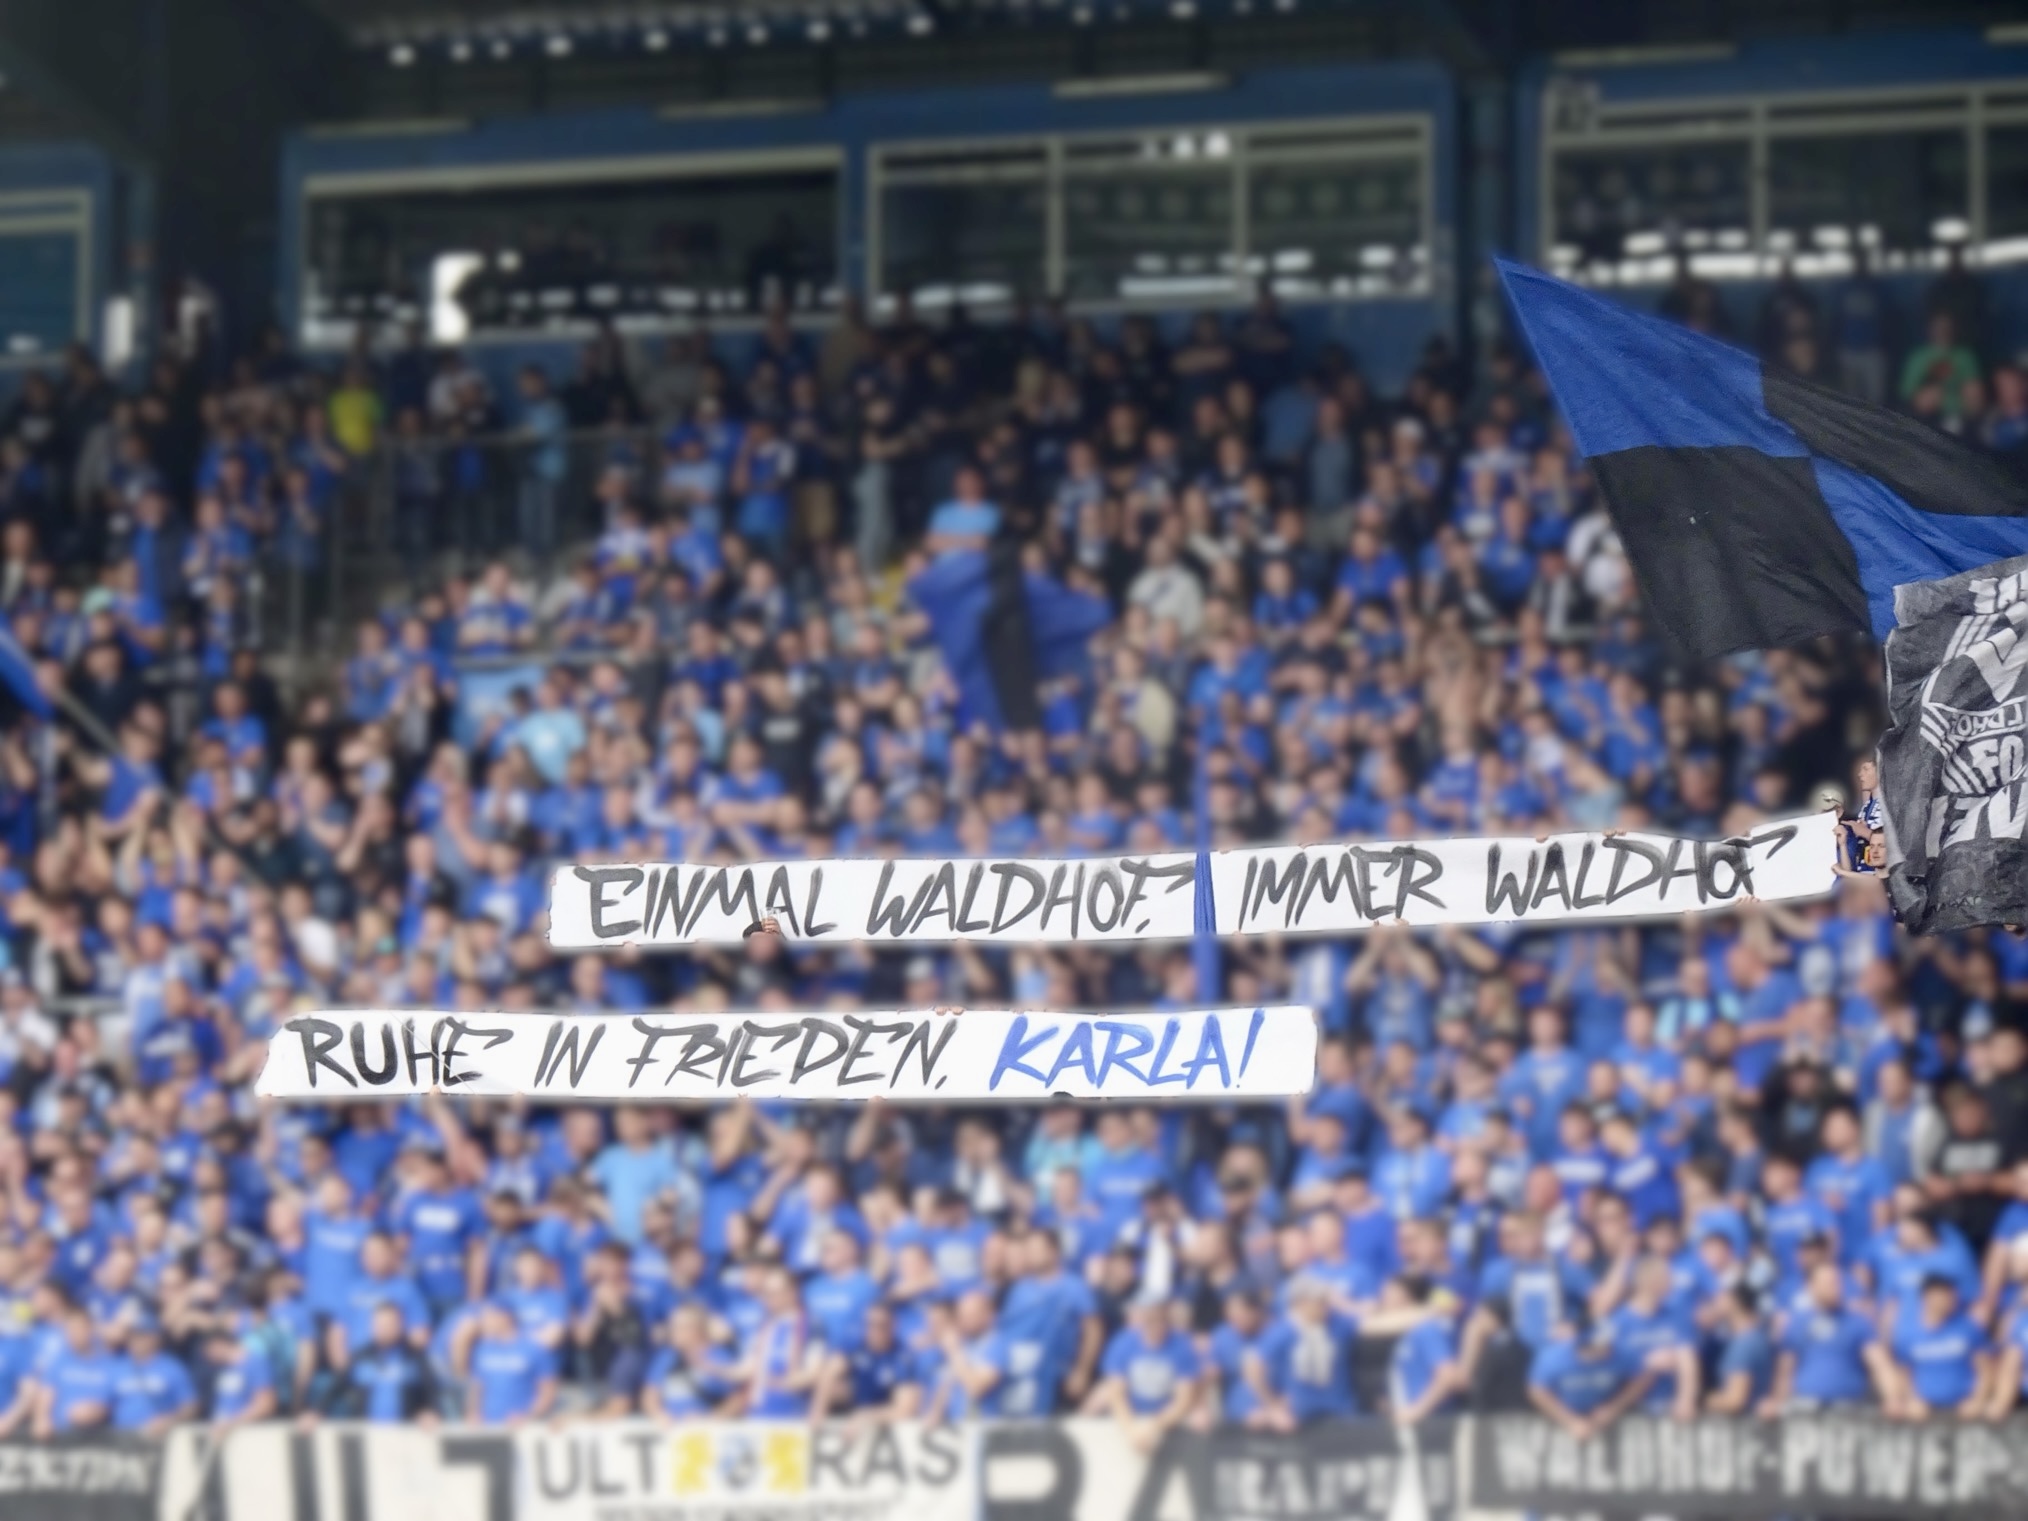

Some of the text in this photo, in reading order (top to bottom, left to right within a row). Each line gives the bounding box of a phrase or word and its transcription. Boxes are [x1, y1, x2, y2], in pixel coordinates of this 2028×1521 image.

[574, 825, 1798, 940] EINMAL WALDHOF, IMMER WALDHOF
[284, 1008, 1265, 1091] RUHE IN FRIEDEN, KARLA!
